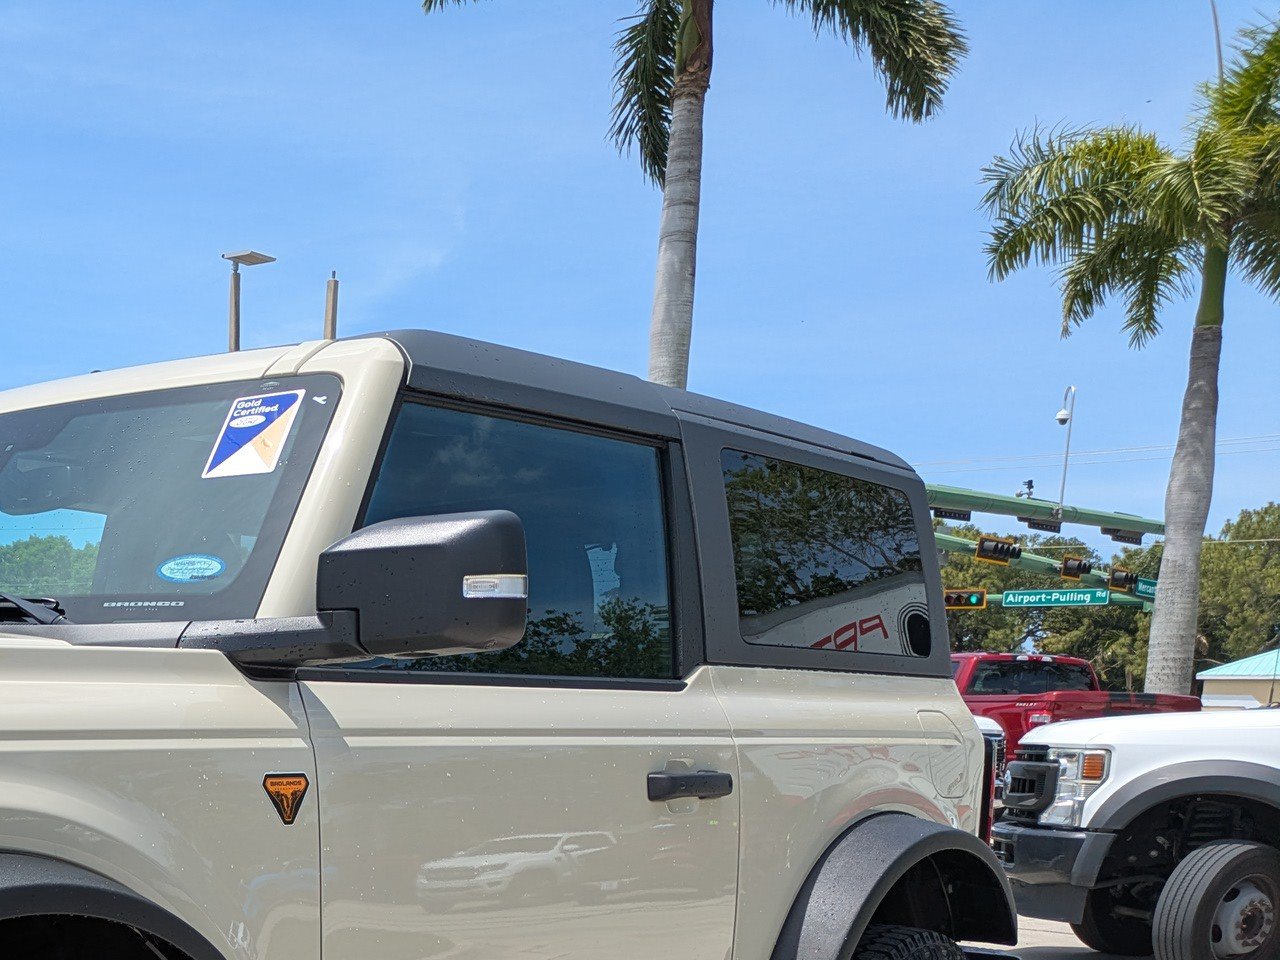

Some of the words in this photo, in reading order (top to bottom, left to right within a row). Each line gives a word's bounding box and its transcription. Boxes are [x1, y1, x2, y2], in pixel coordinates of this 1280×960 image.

[236, 399, 262, 409] Gold
[233, 404, 279, 417] Certified
[1006, 592, 1091, 604] Airport-Pulling
